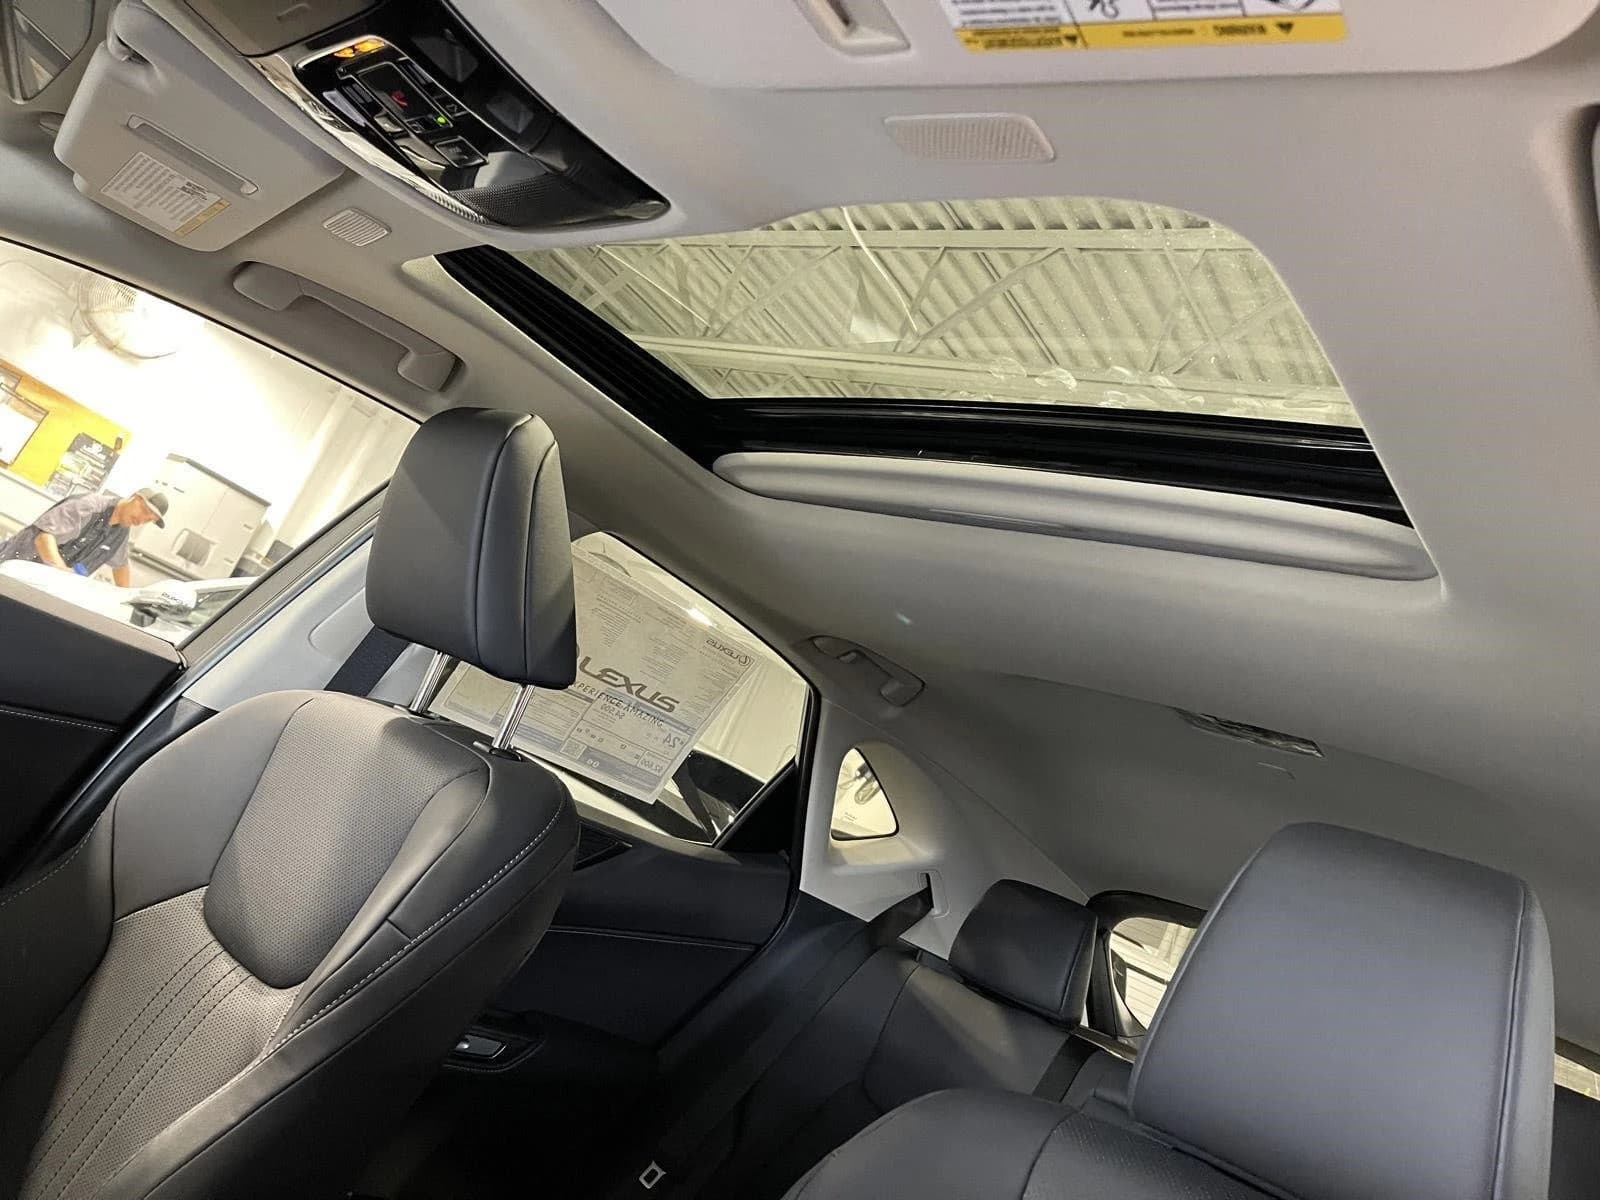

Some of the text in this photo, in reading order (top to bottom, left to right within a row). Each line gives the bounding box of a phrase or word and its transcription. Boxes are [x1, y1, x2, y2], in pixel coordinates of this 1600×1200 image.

[573, 681, 623, 708] PERIENCE
[623, 703, 664, 727] AMAZING
[579, 656, 680, 713] LEXUS
